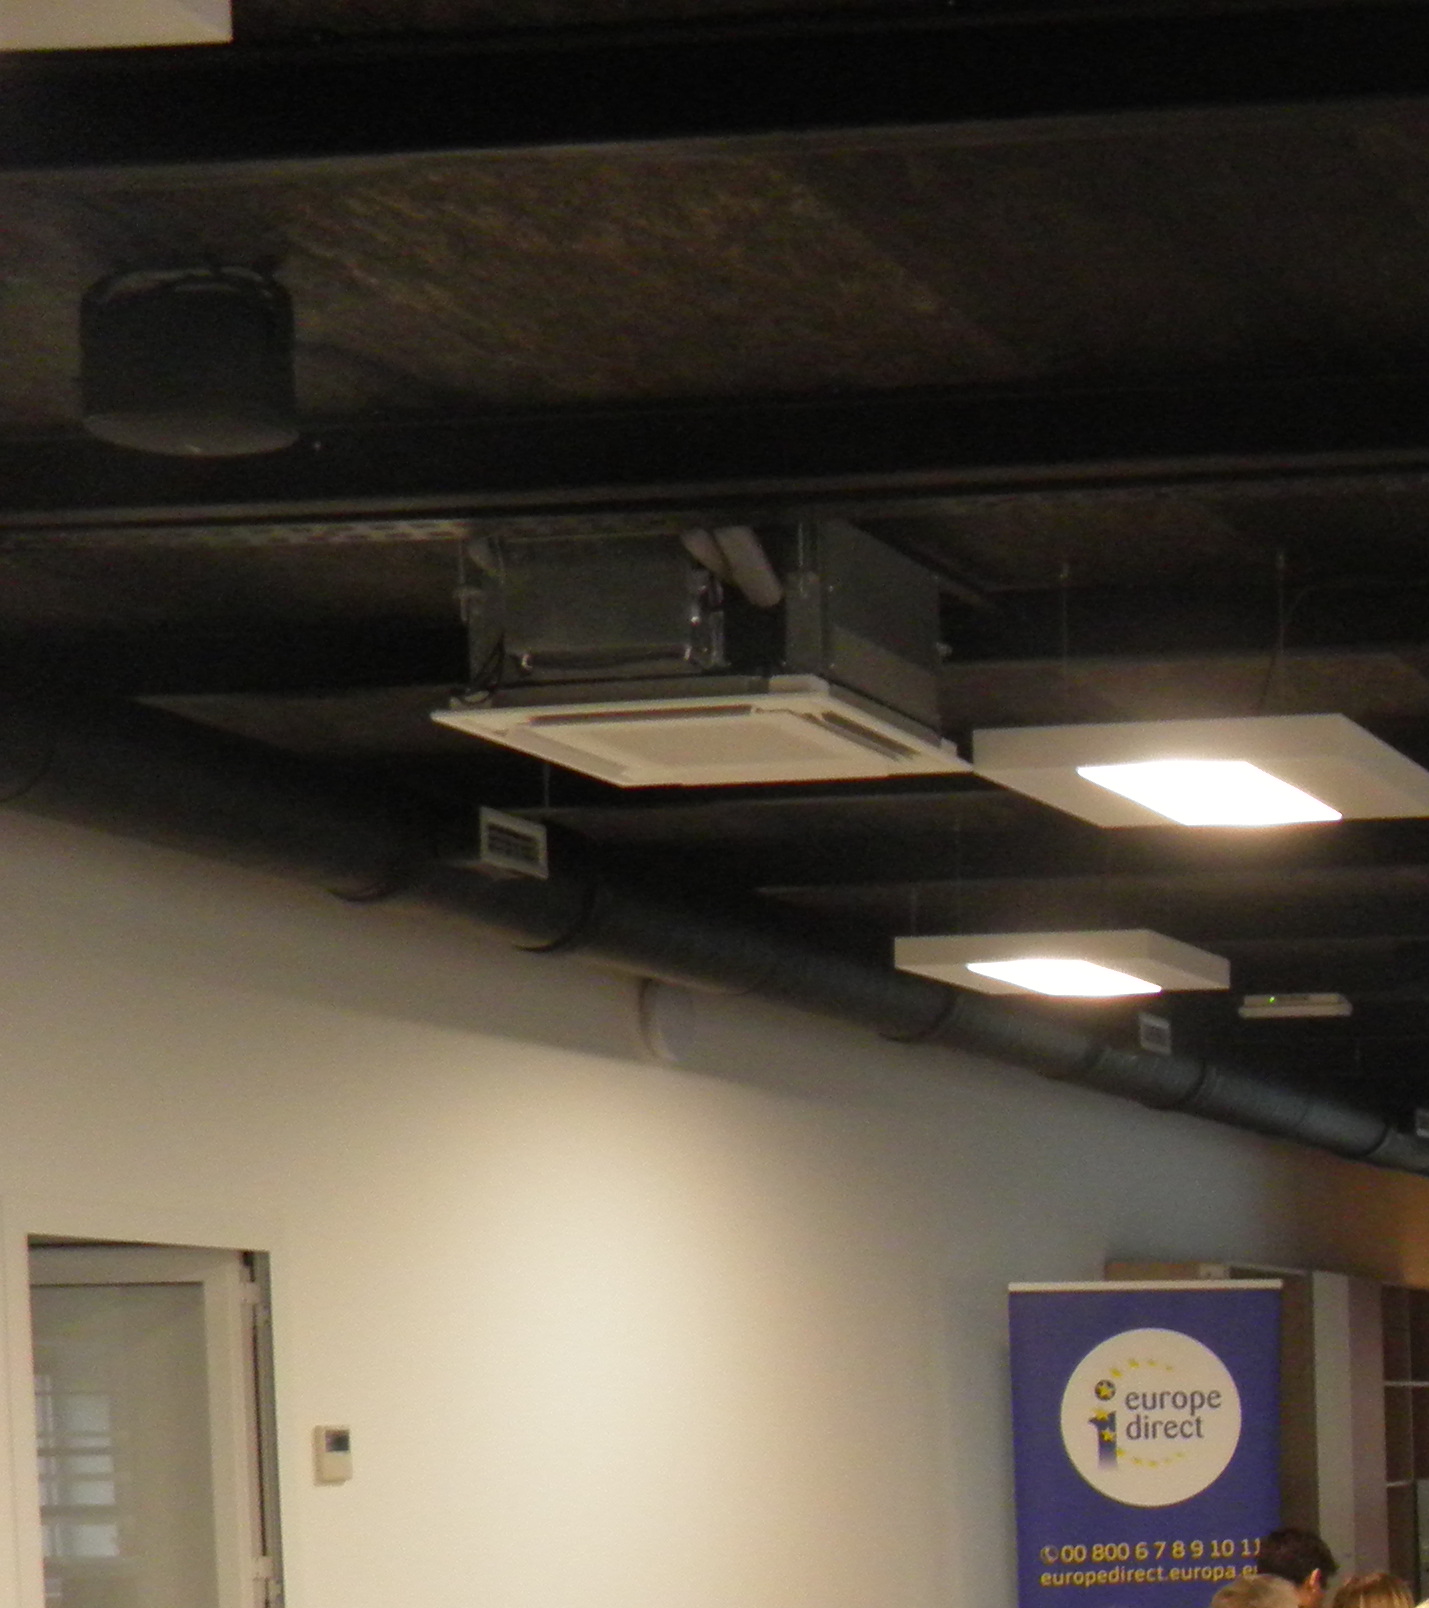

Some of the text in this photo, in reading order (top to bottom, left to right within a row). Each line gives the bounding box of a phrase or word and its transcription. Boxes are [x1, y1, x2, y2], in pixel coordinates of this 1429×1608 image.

[1125, 1389, 1222, 1416] europe
[1125, 1414, 1205, 1440] direct
[1060, 1544, 1087, 1562] 00
[1091, 1542, 1130, 1561] 800
[1134, 1541, 1149, 1560] 6
[1153, 1541, 1167, 1559] 7
[1171, 1540, 1185, 1559] 8
[1190, 1540, 1204, 1559] 9
[1210, 1539, 1235, 1558] 10
